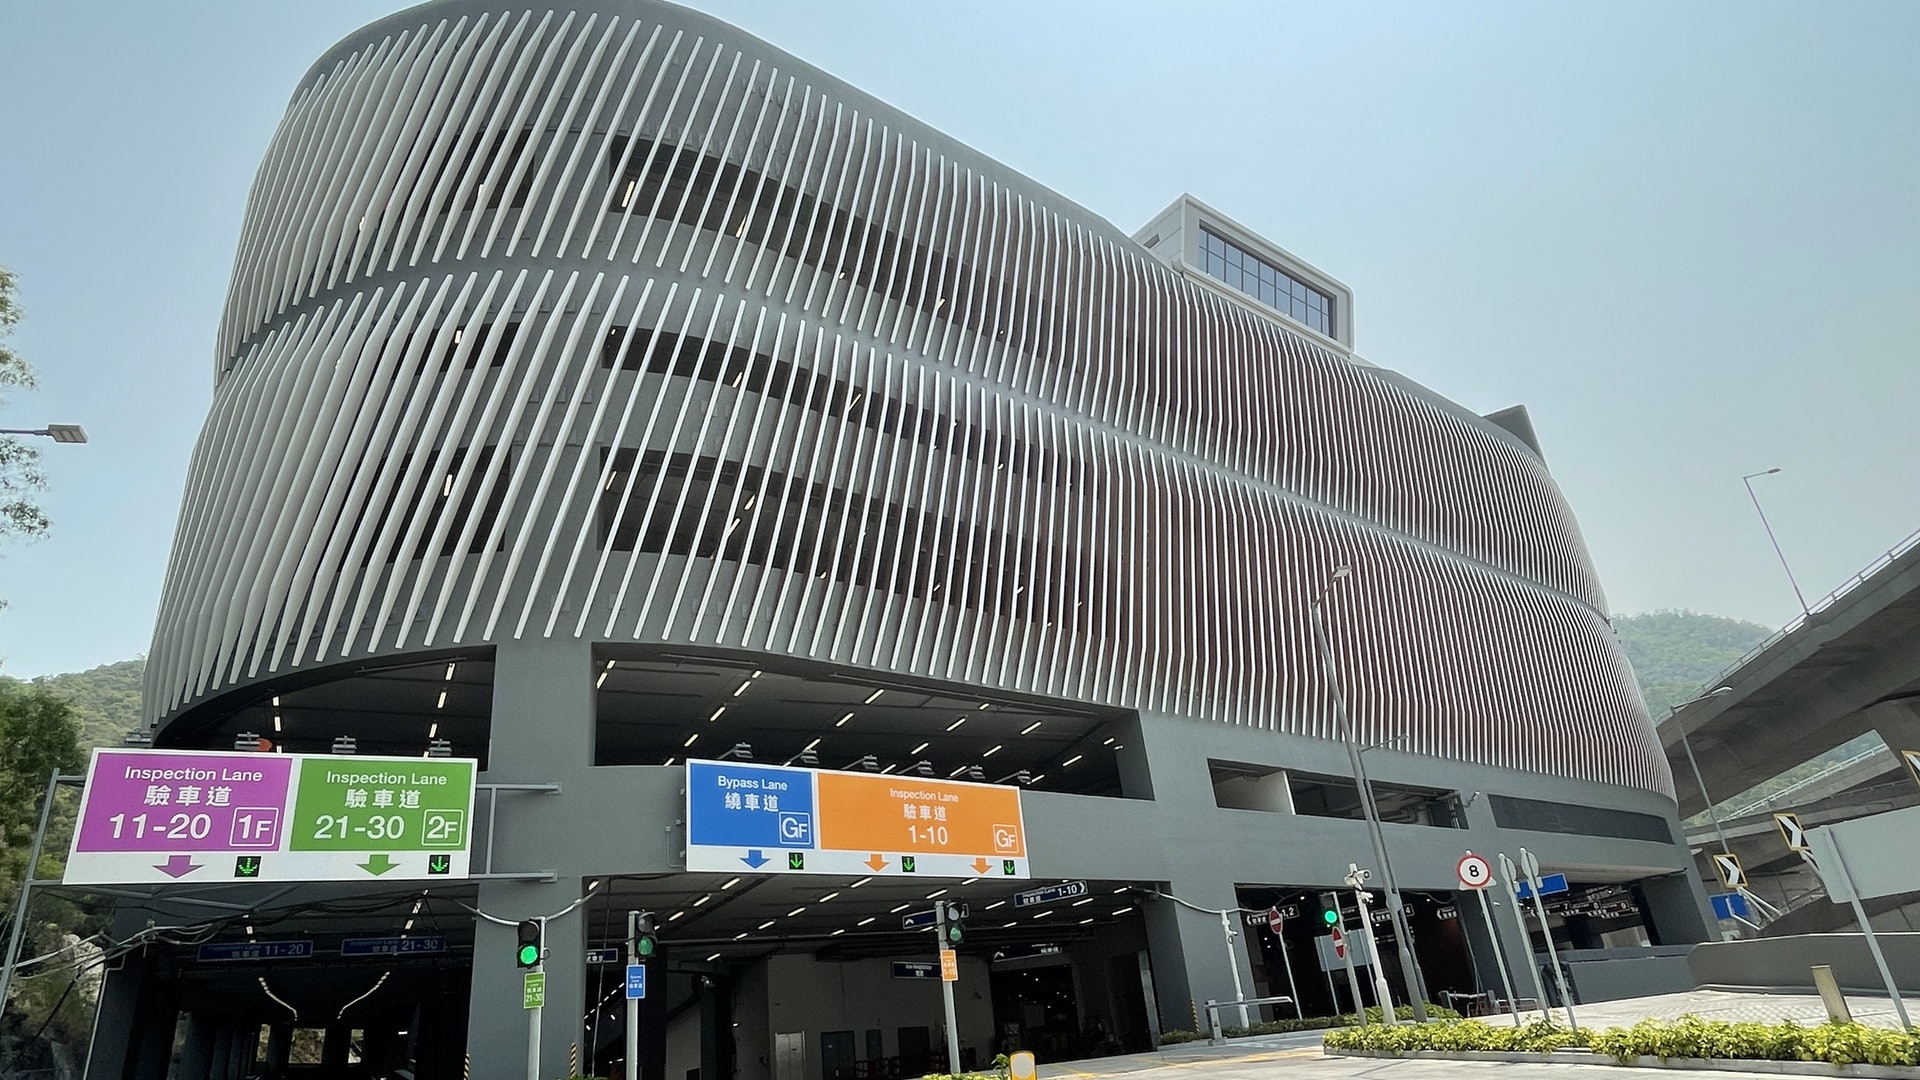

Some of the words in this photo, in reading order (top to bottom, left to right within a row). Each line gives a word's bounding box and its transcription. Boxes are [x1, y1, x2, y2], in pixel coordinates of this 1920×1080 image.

[124, 766, 216, 782] Inspection
[221, 768, 263, 782] Lane
[326, 771, 406, 785] Inspection
[411, 773, 447, 785] Lane
[718, 775, 759, 789] Bypass
[761, 779, 788, 791] Lane
[143, 785, 232, 807] 驗車道
[345, 789, 421, 809] 驗車道
[725, 792, 779, 812] 繞車道
[889, 788, 936, 800] Inspection
[938, 792, 959, 802] Lane
[903, 803, 947, 821] 驗車道
[109, 813, 212, 839] 11-20
[238, 814, 273, 839] 1F
[313, 814, 405, 840] 21-30
[426, 815, 458, 839] 2F
[782, 817, 807, 838] GF
[908, 825, 948, 845] 1-10
[995, 829, 1016, 847] GF
[1469, 865, 1479, 877] 8
[1057, 884, 1077, 896] 1-10
[264, 943, 304, 956] 11-20
[401, 939, 438, 950] 21-30
